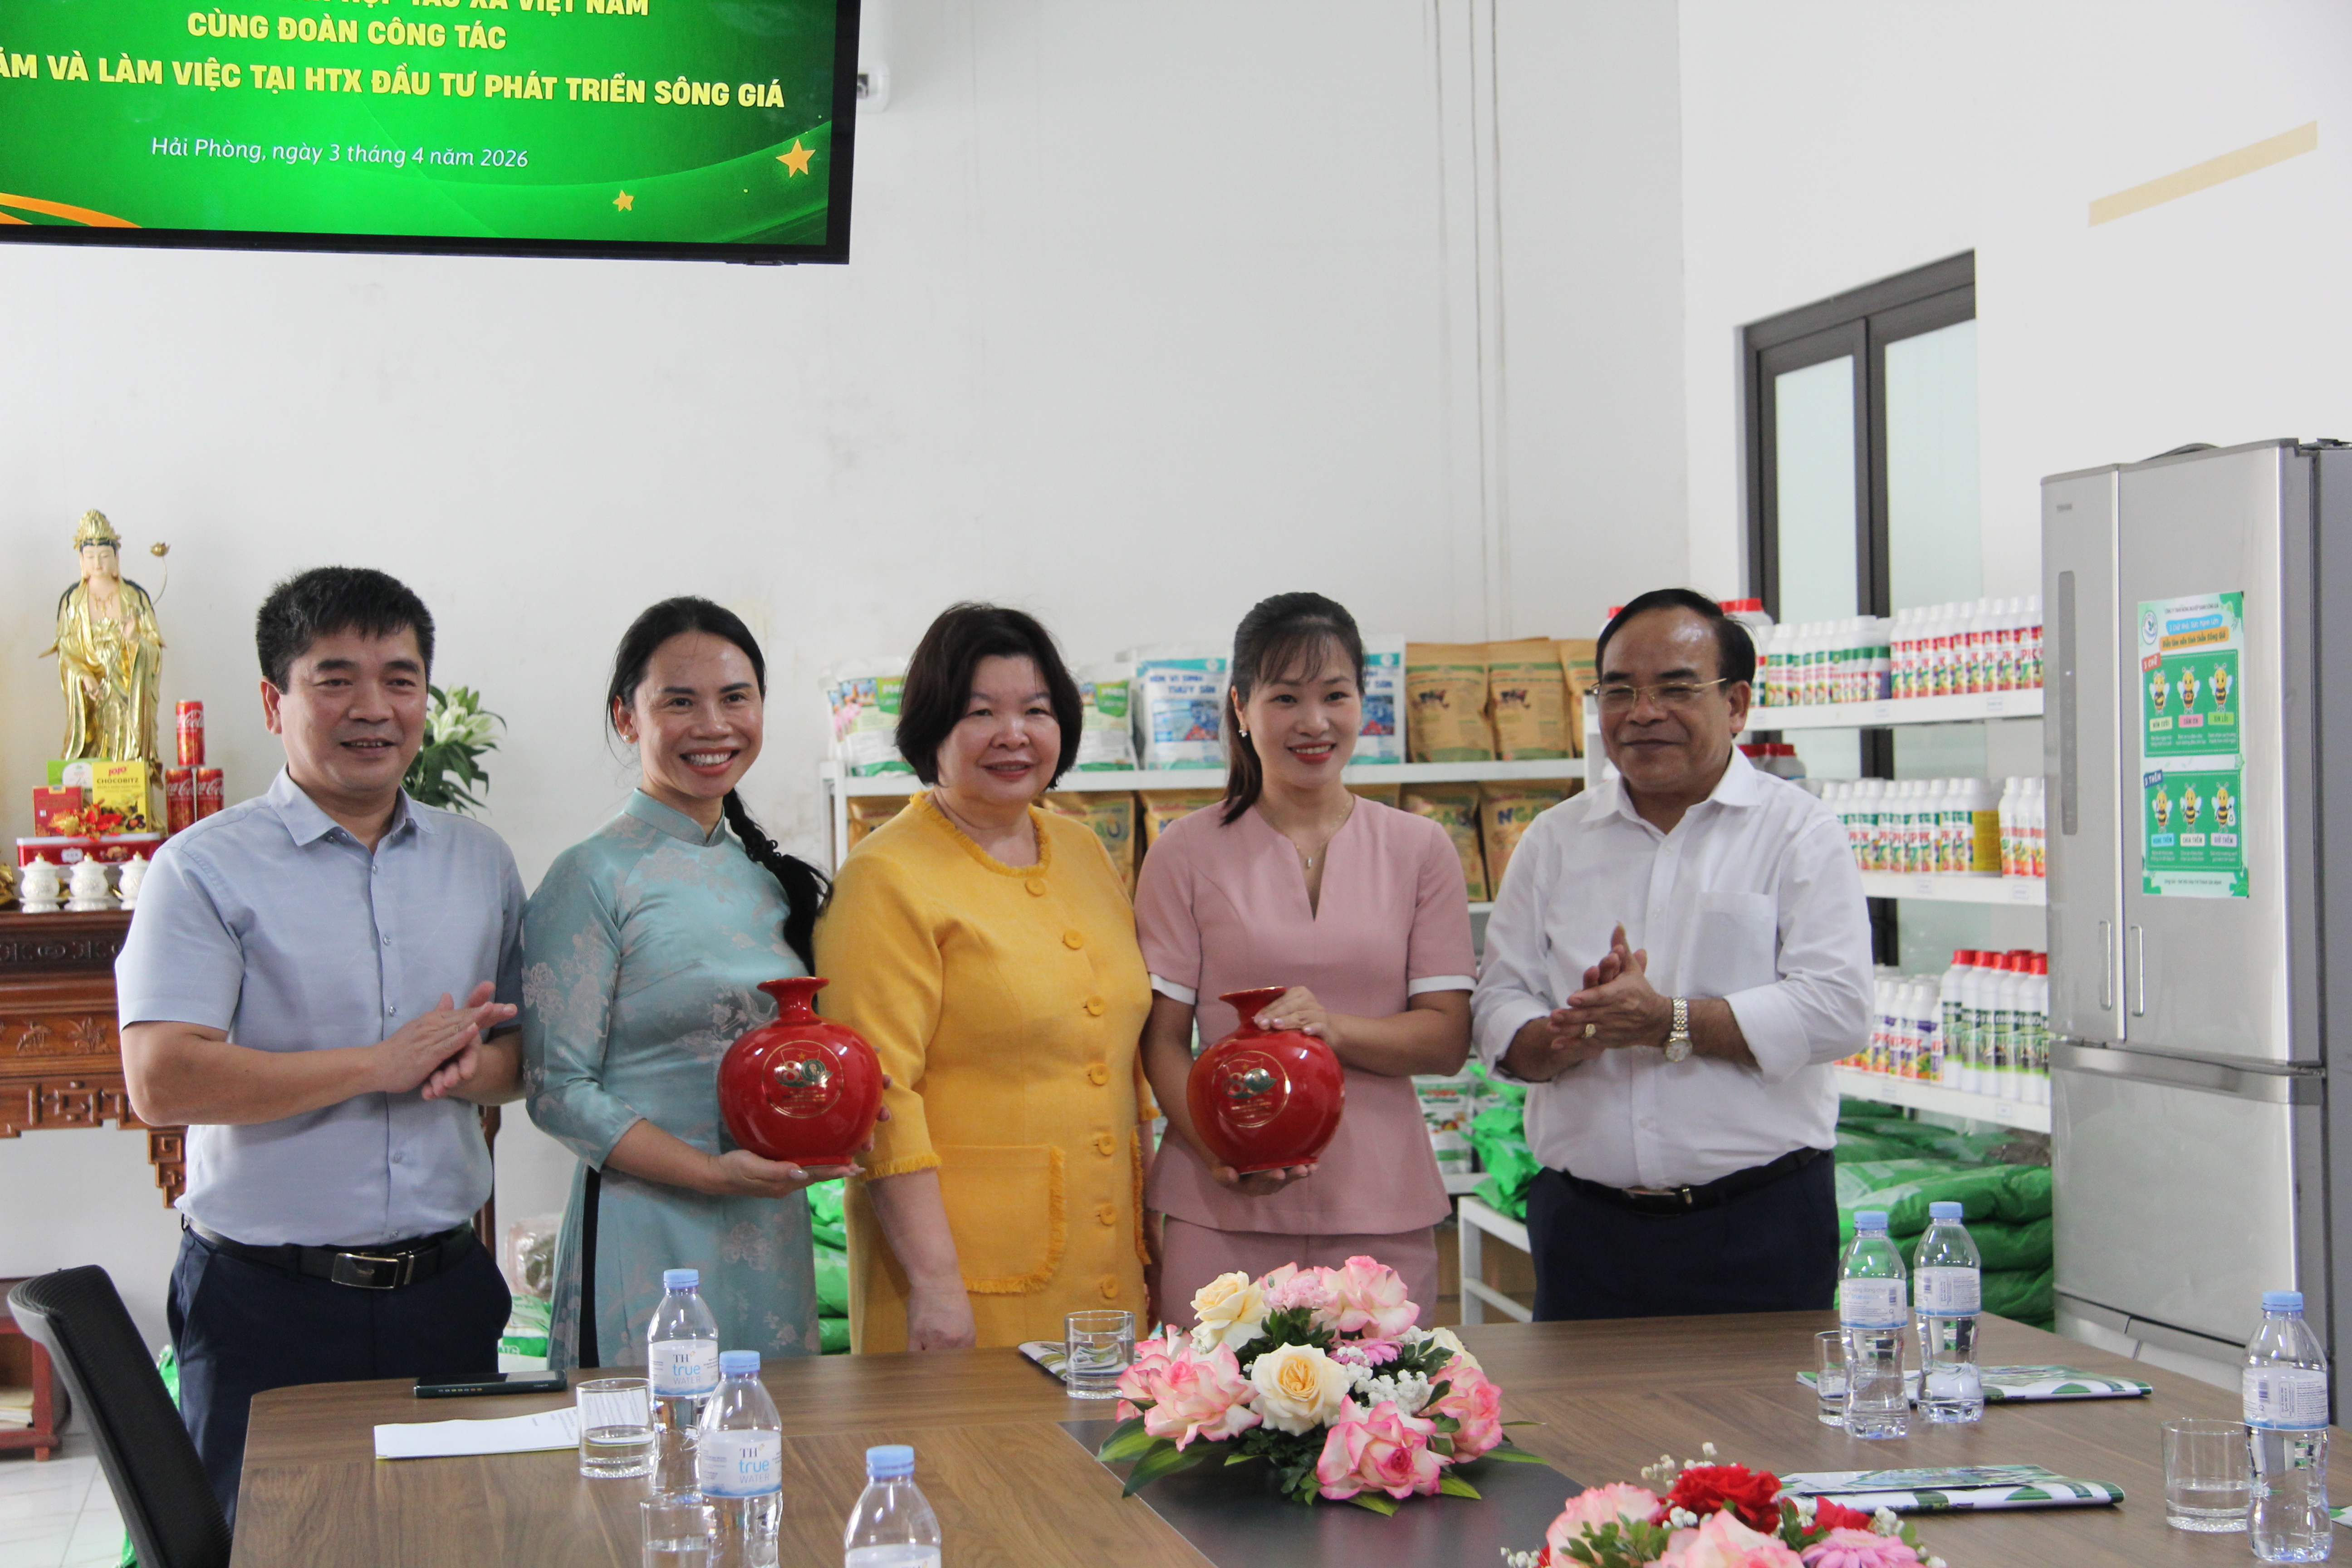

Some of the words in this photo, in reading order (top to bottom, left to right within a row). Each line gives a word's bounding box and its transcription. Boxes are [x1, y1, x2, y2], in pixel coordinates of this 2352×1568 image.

[187, 8, 269, 39] CÙNG
[277, 13, 358, 44] ĐOÀN
[368, 16, 446, 47] CÔNG
[454, 20, 506, 49] TÁC
[46, 50, 90, 81] VÀ
[98, 52, 163, 84] LÀM
[172, 57, 241, 92] VIỆC
[250, 64, 295, 94] TẠI
[305, 67, 363, 93] HTX
[371, 63, 431, 96] ĐẦU
[439, 71, 478, 97] TƯ
[485, 70, 558, 100] PHÁT
[565, 72, 646, 103] TRIỂN
[654, 76, 730, 107] SÔNG
[737, 78, 785, 108] GIÁ
[152, 137, 188, 157] Hải
[195, 138, 266, 163] Phòng,
[273, 142, 323, 165] ngày
[329, 144, 340, 161] 3
[348, 144, 406, 168] tháng
[412, 147, 424, 164] 4
[430, 147, 474, 166] năm
[480, 148, 529, 167] 2026
[673, 1354, 689, 1362] TH
[673, 1364, 701, 1376] true
[674, 1376, 701, 1384] WATER
[740, 1447, 758, 1458] TH
[739, 1460, 769, 1473] true
[740, 1473, 769, 1483] WATER
